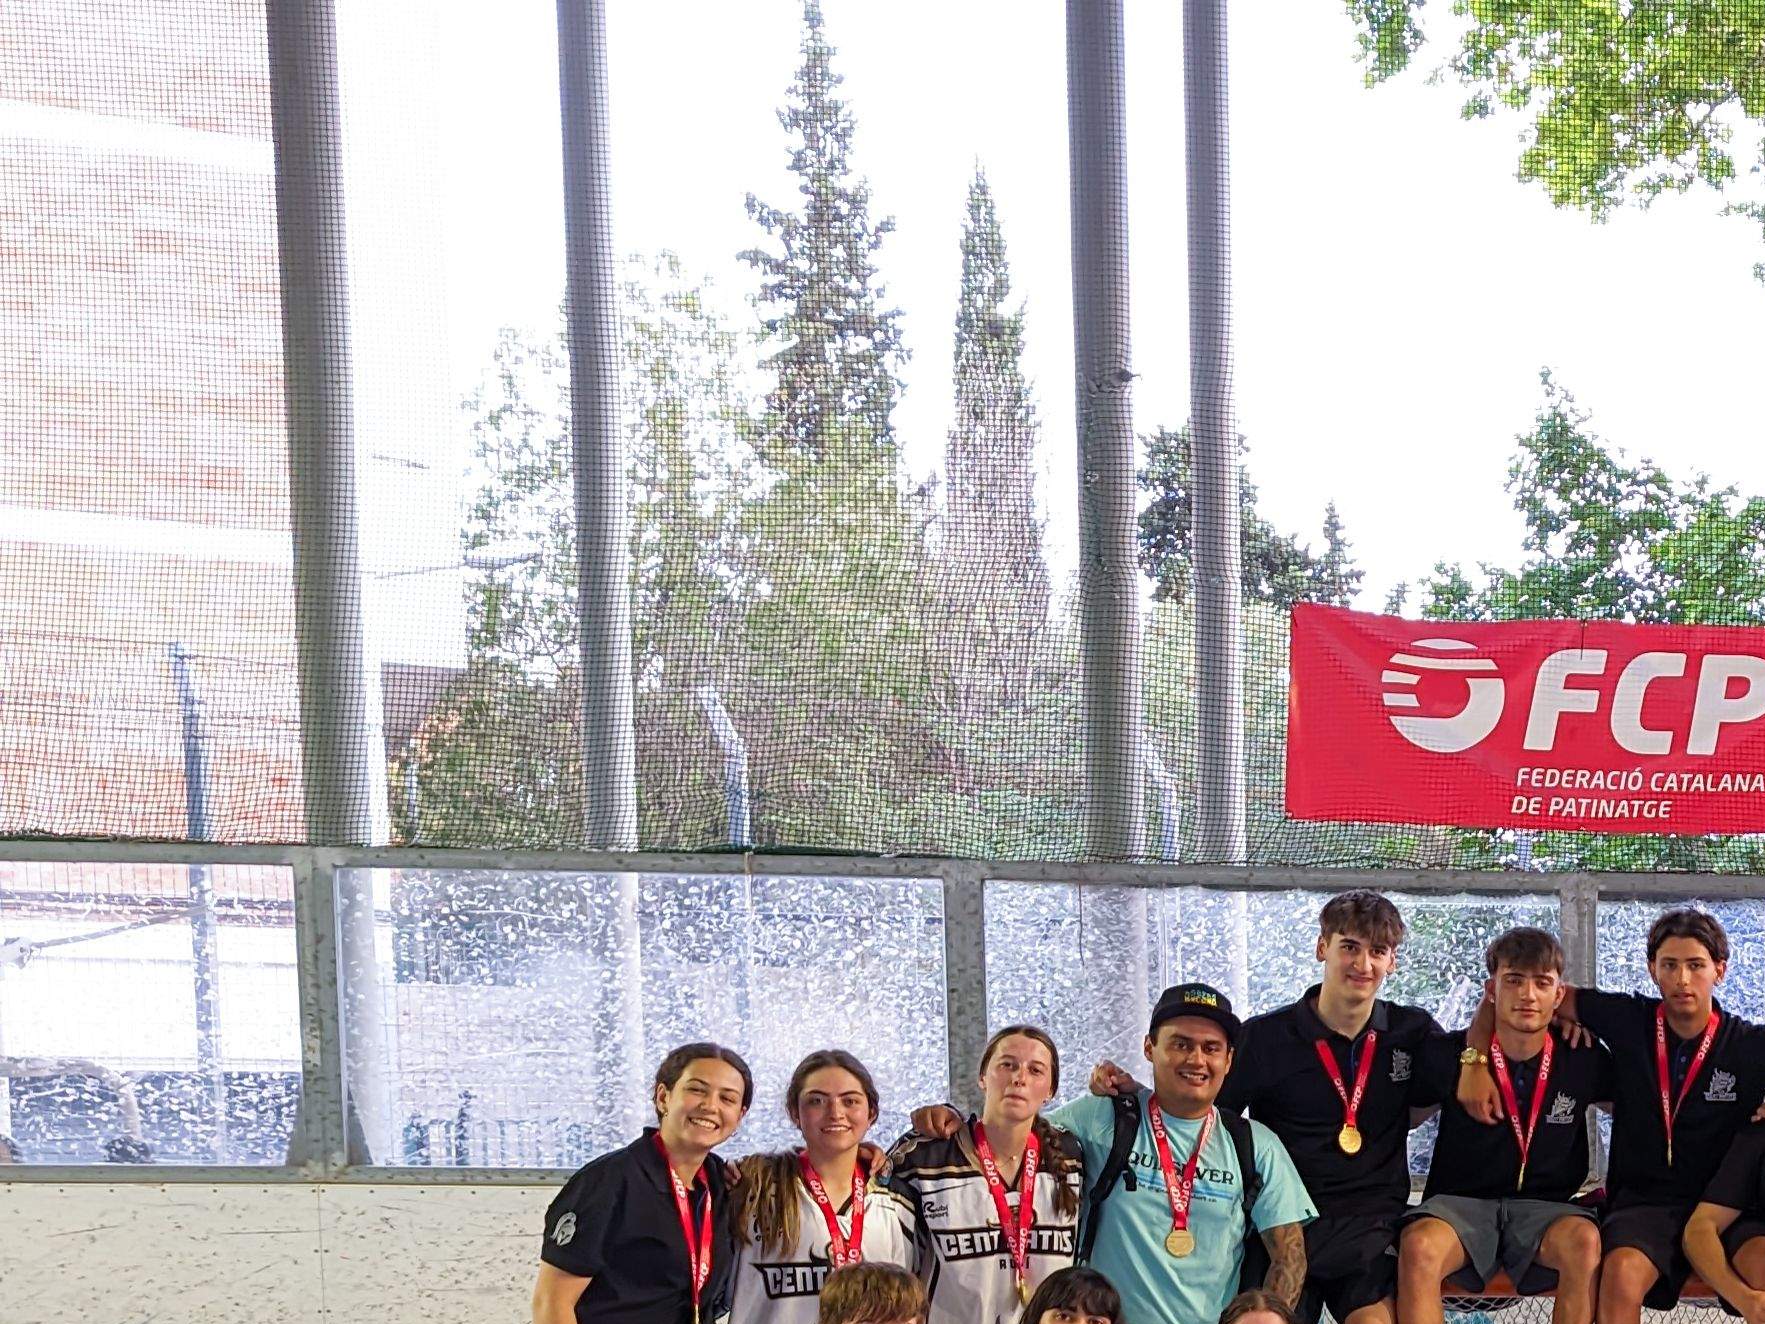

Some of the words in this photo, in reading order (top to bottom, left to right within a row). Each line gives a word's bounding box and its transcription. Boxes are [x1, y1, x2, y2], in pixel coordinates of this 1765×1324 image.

[1516, 767, 1643, 792] FEDERACIÓ
[1650, 771, 1765, 793] CATALANA
[1511, 795, 1541, 815] DE
[1549, 796, 1672, 819] PATINATGE
